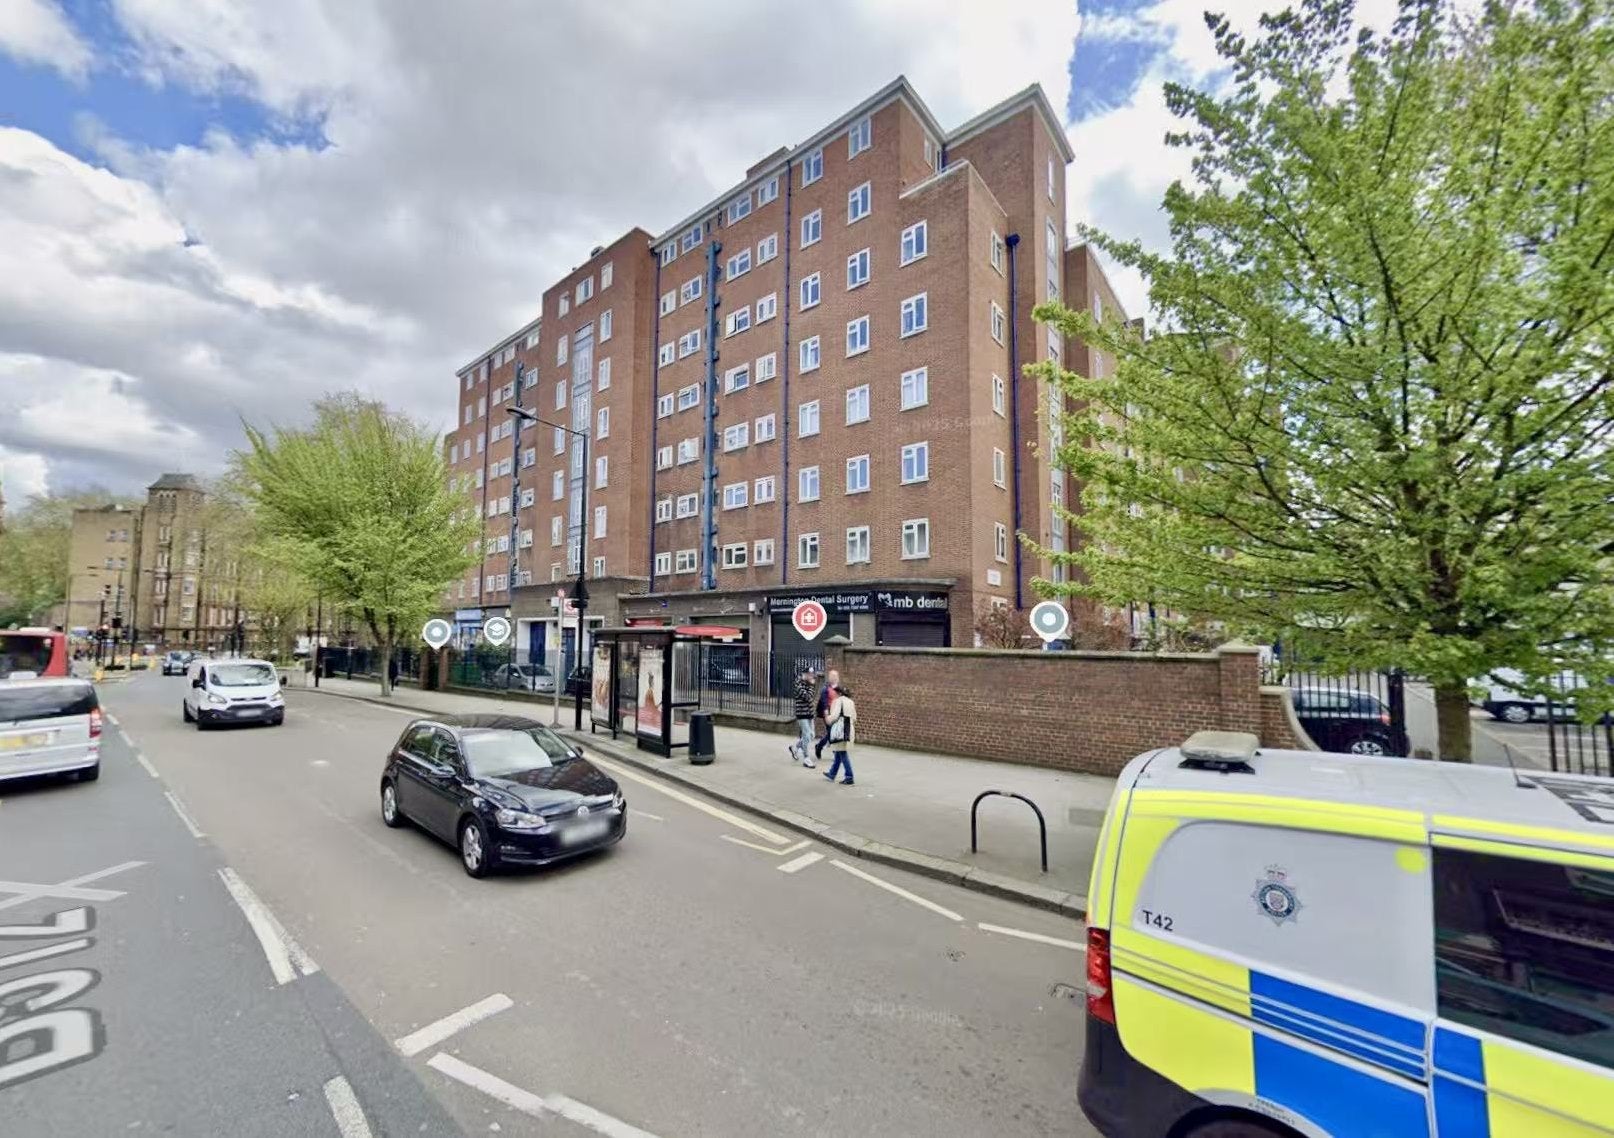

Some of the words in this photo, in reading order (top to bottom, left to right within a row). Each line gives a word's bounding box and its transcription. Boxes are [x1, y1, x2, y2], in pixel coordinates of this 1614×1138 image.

[811, 595, 835, 604] Dental
[836, 594, 869, 604] Surgery
[893, 595, 914, 608] mb
[916, 596, 948, 609] dental
[1142, 909, 1174, 932] T42
